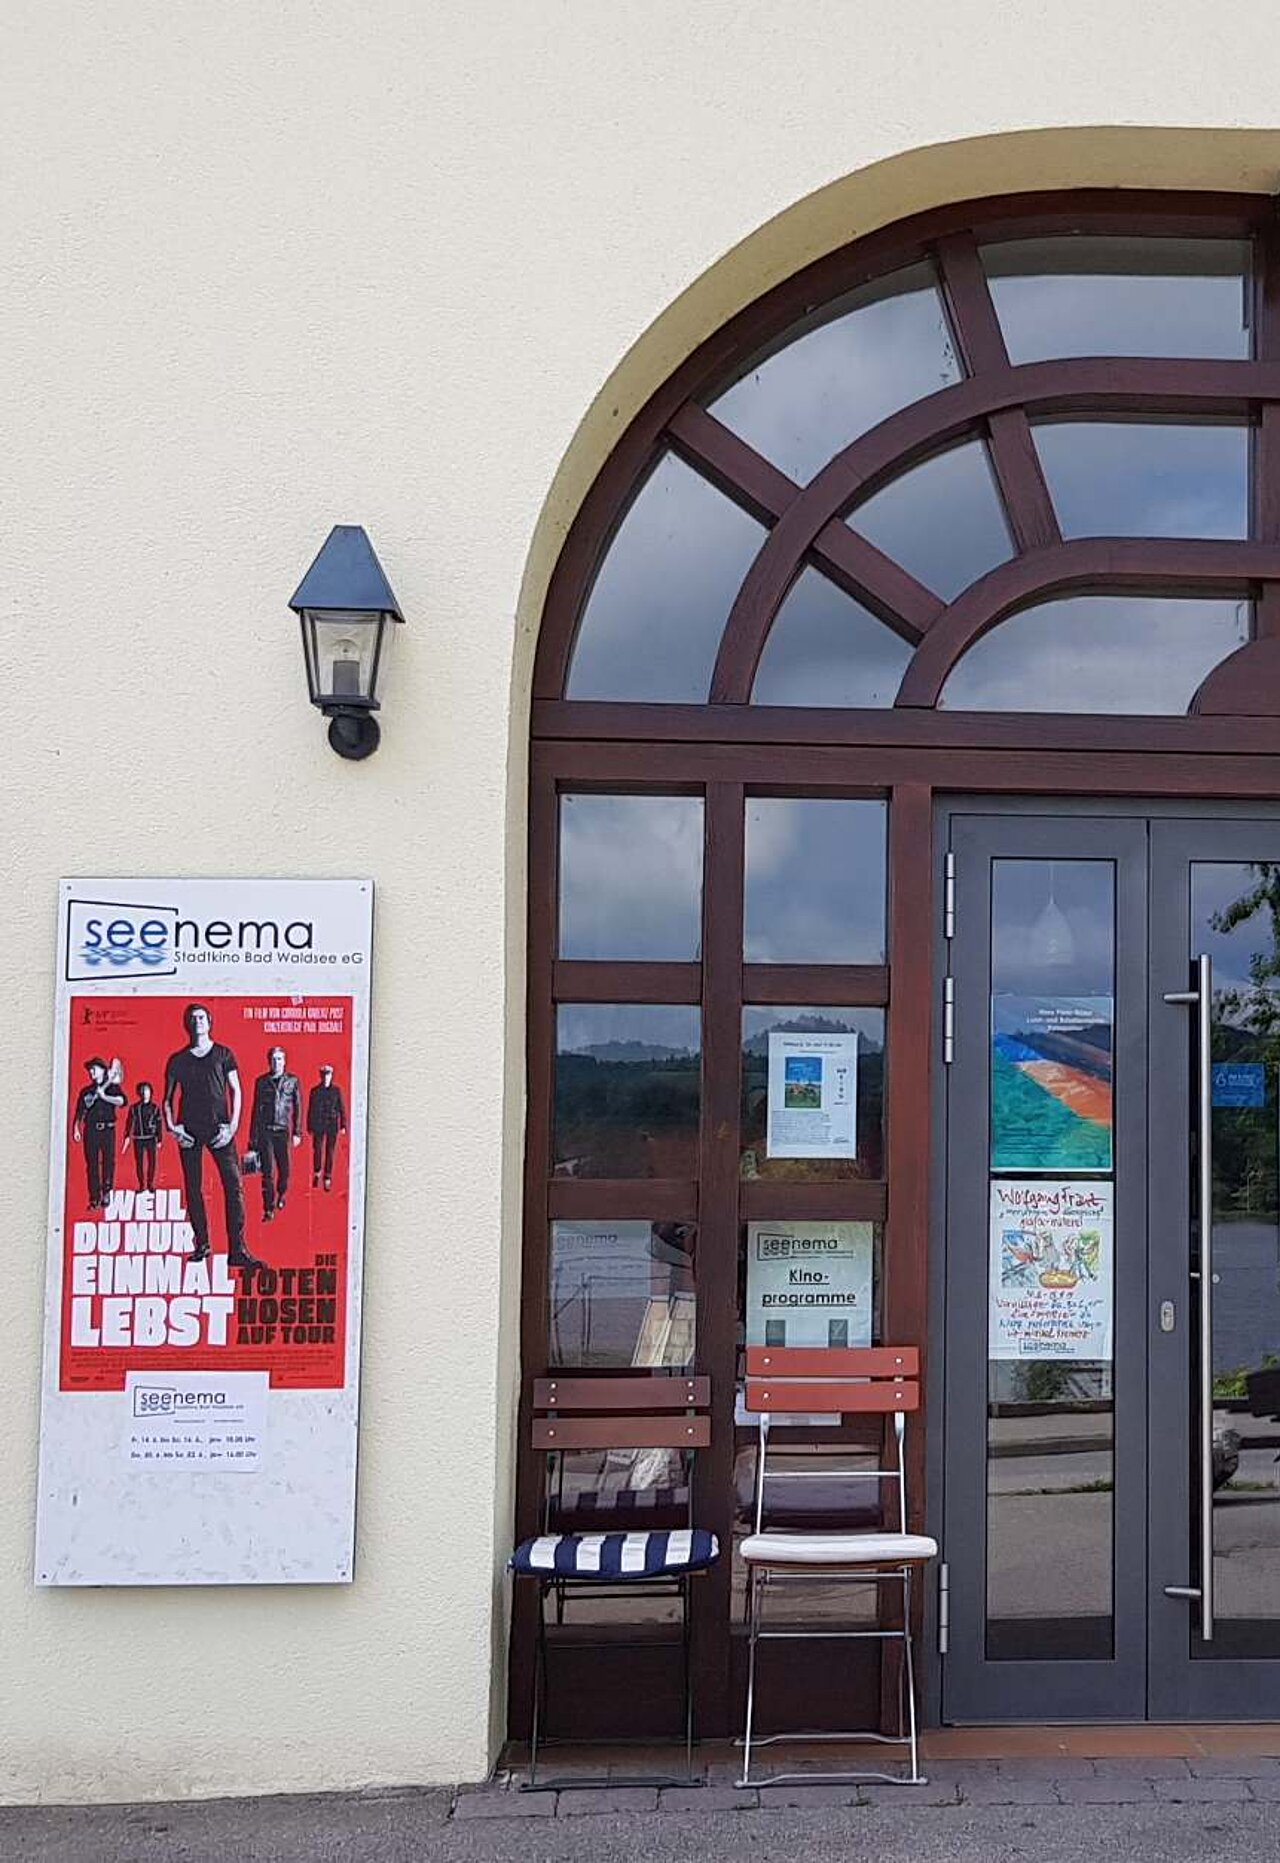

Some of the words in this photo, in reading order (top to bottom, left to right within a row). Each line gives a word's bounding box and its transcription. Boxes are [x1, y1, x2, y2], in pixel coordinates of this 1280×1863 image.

[85, 919, 313, 949] seenema
[174, 951, 240, 964] Stadtkino
[244, 951, 273, 964] Bad
[277, 951, 337, 965] Waldsee
[341, 952, 364, 965] eG
[105, 1189, 186, 1221] WEIL
[73, 1222, 122, 1253] DU
[124, 1222, 196, 1254] NUR
[763, 1239, 838, 1250] seenema
[315, 1254, 337, 1266] DIE
[72, 1253, 235, 1295] EINMAL
[238, 1268, 337, 1296] TOTEN
[789, 1268, 830, 1283] Kino-
[237, 1297, 337, 1325] HOSEN
[762, 1292, 857, 1307] programme
[71, 1296, 234, 1346] LEBST
[236, 1326, 276, 1345] AUF
[281, 1326, 335, 1345] TOUR
[140, 1391, 226, 1406] seenema
